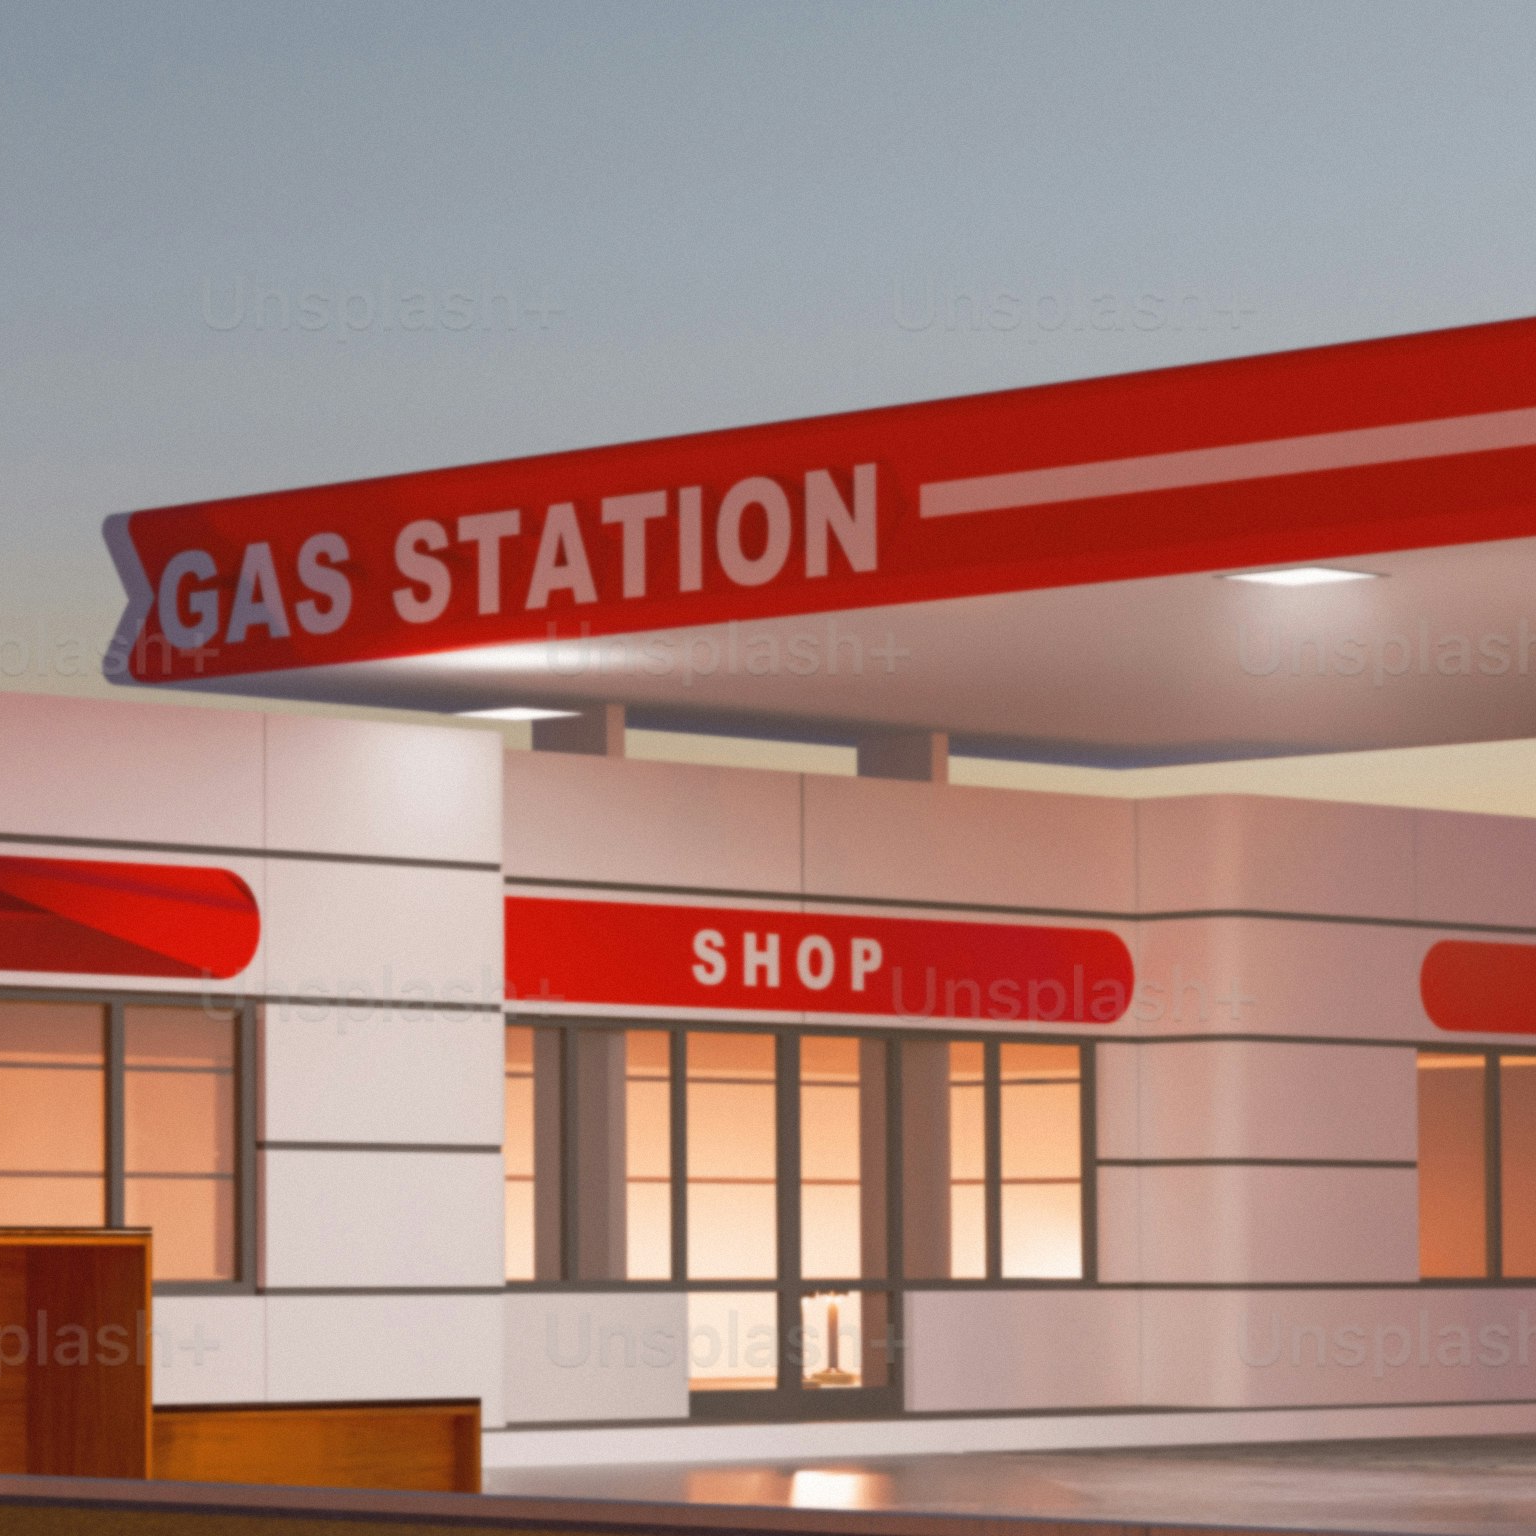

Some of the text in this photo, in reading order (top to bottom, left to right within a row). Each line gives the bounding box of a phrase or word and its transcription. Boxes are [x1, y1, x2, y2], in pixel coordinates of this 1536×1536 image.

[157, 462, 878, 650] GAS STATION
[691, 930, 884, 991] SHOP
